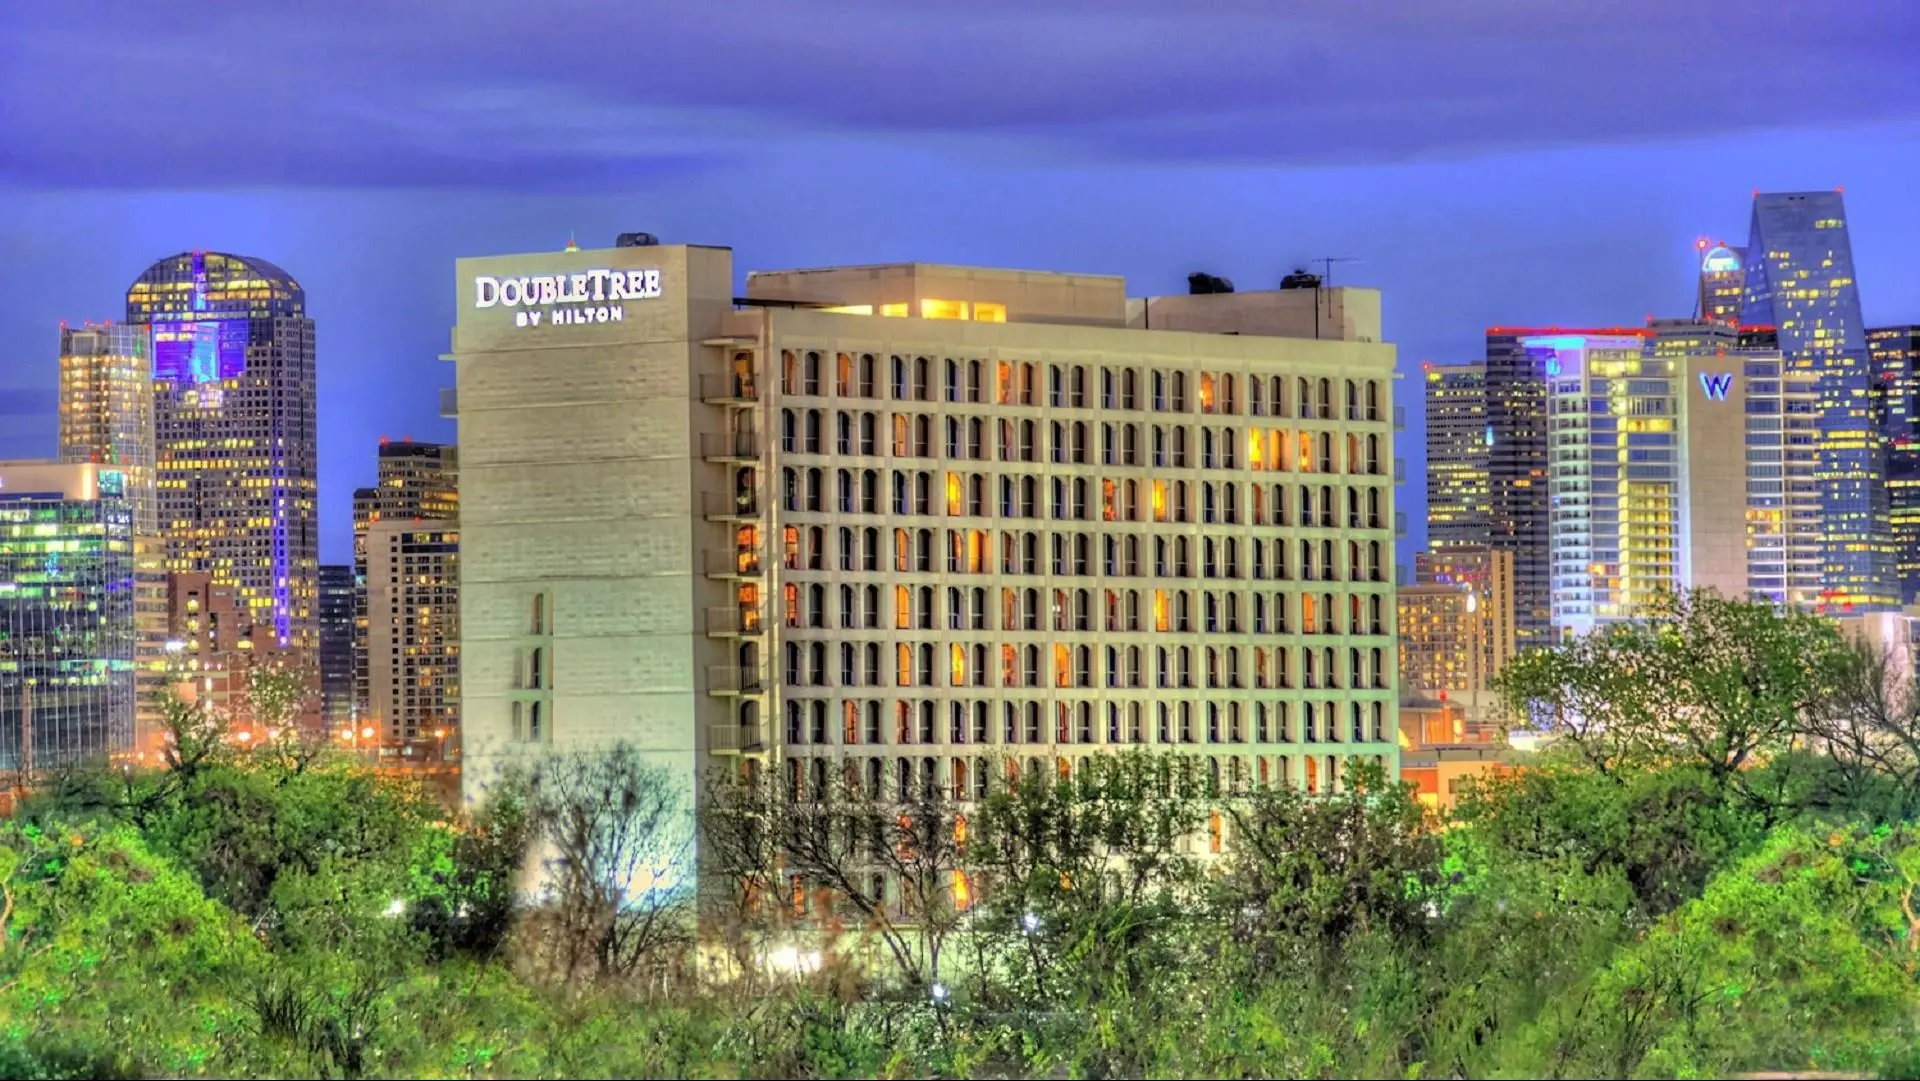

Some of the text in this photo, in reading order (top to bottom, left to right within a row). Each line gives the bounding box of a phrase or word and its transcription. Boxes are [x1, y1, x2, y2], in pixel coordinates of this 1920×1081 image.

[516, 307, 622, 327] BY HILTON
[1699, 371, 1732, 401] W
